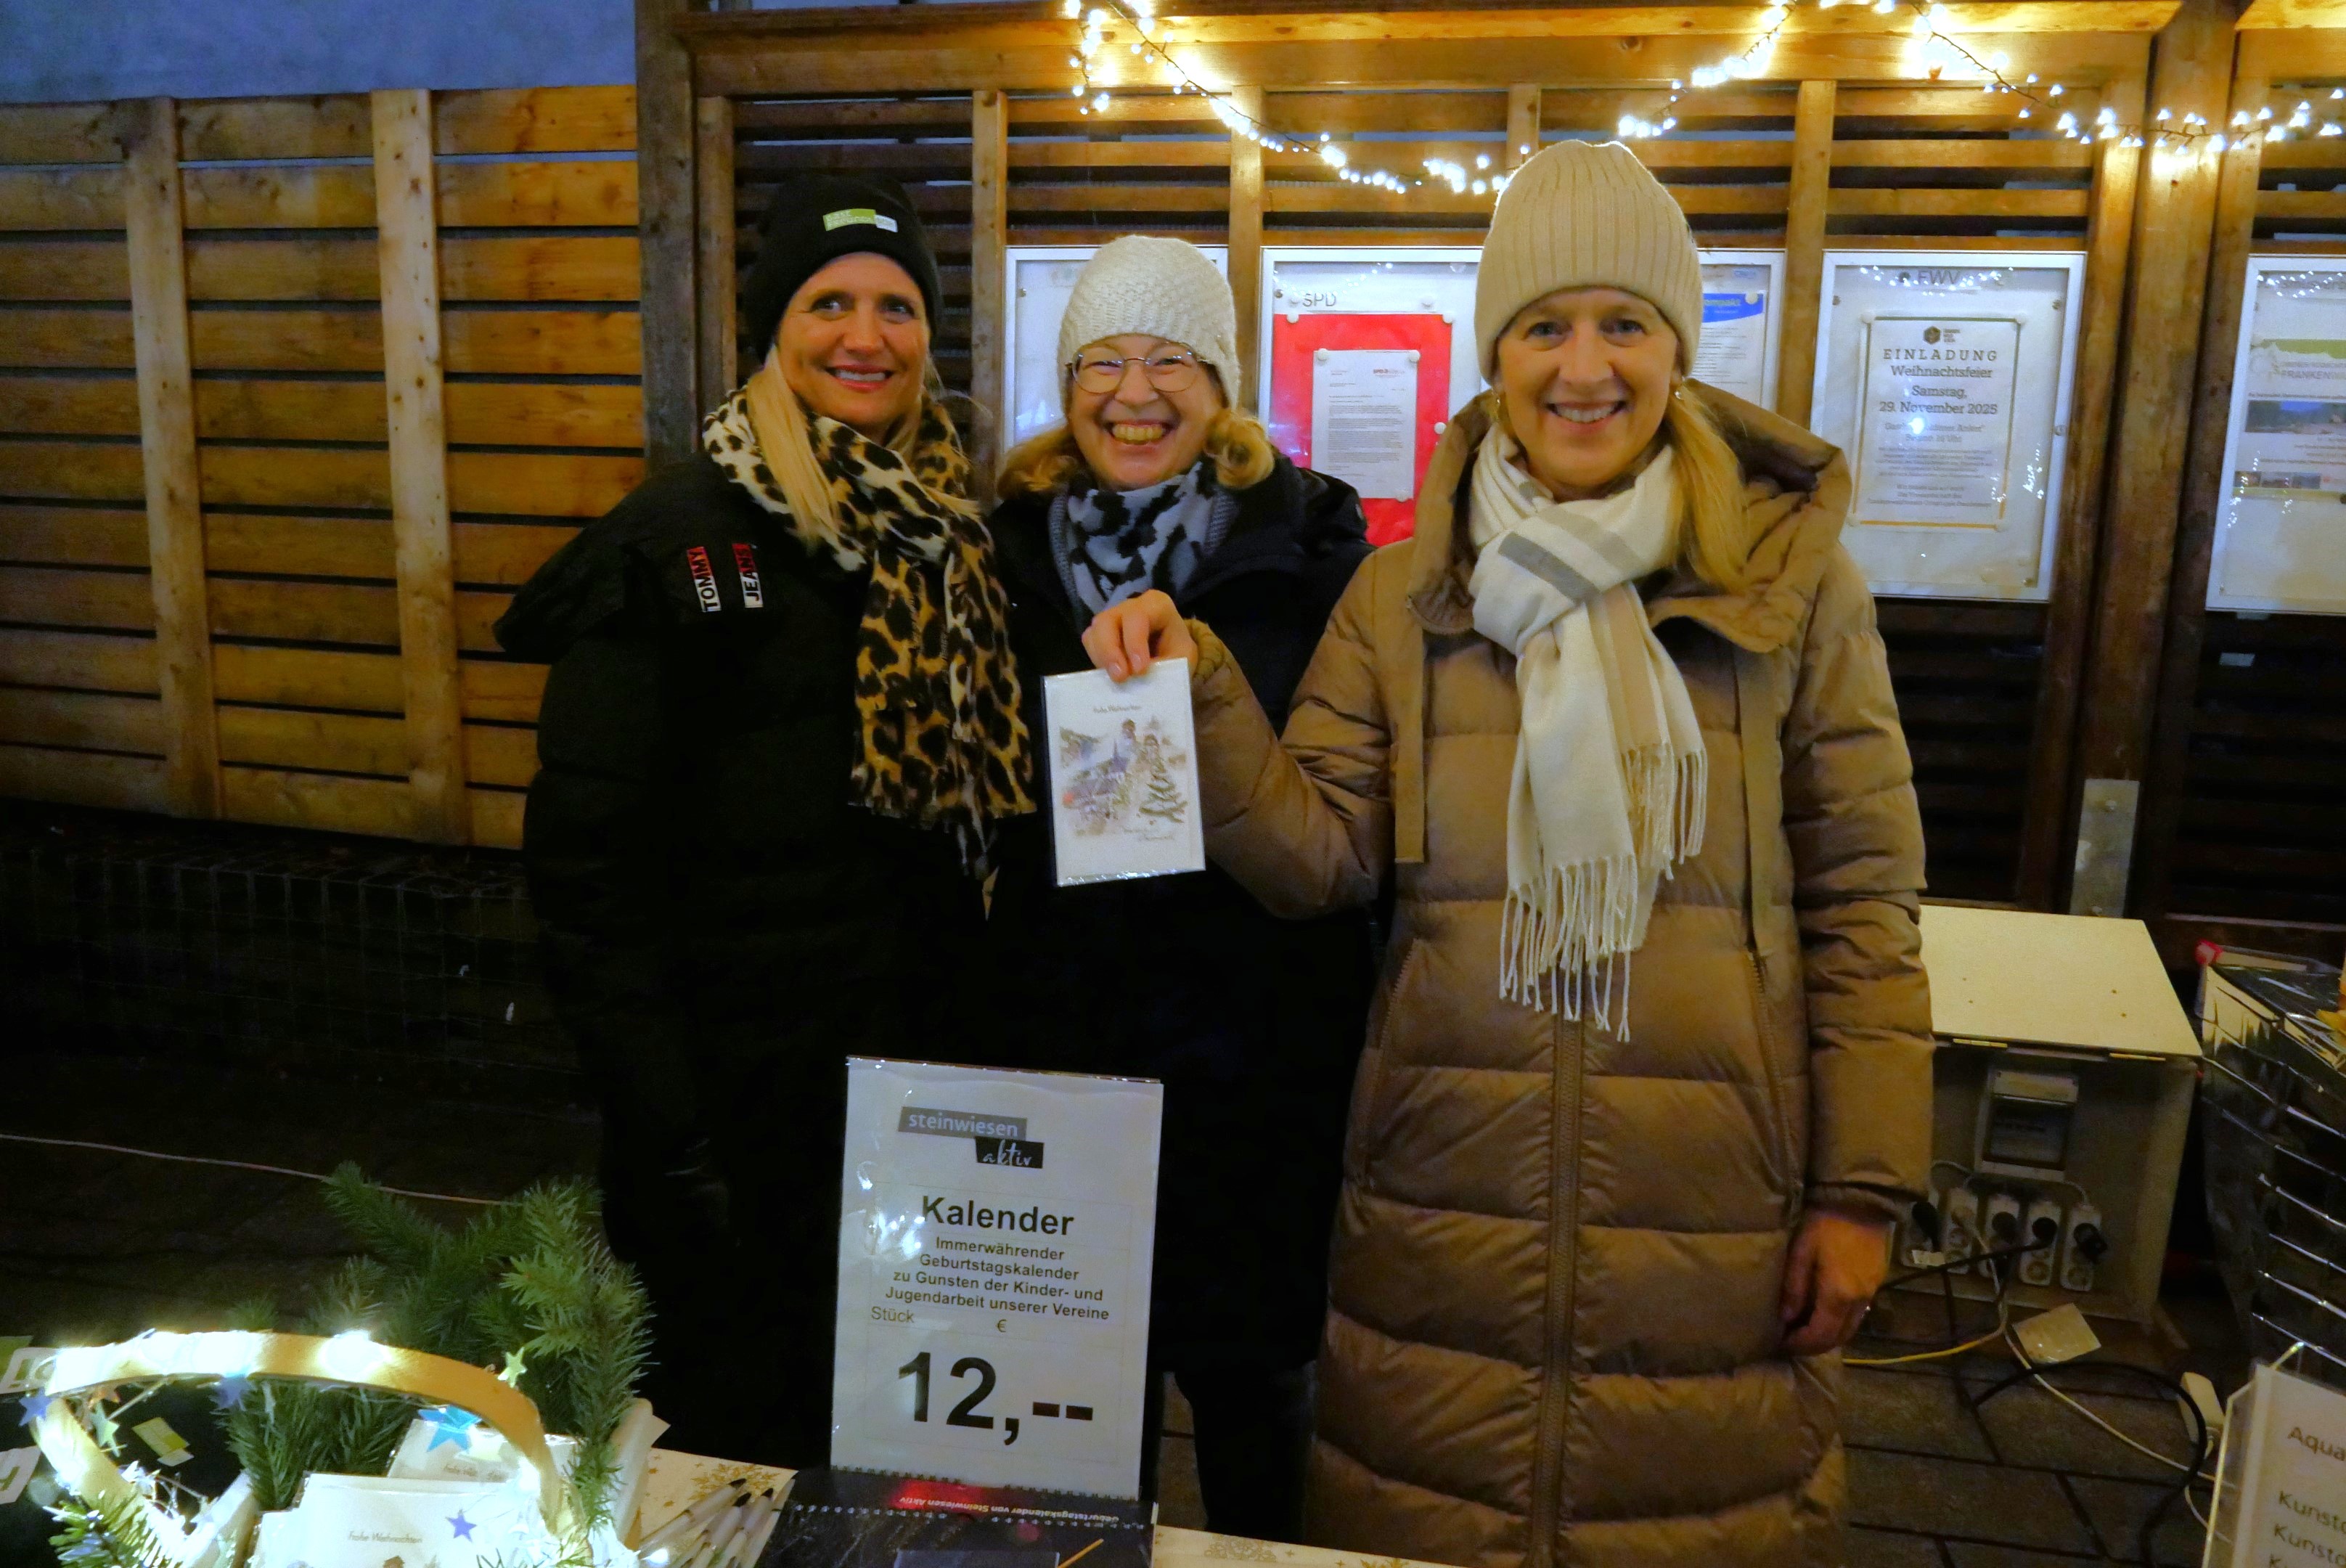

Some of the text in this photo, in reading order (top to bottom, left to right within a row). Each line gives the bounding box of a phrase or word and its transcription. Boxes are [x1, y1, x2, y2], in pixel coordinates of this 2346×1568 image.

[1302, 293, 1336, 307] SPD
[1883, 348, 1997, 361] EINLADUNG
[1891, 365, 1993, 378] Weihnachtsfeier
[1911, 385, 1968, 399] Samstag,
[1900, 401, 1964, 414] November
[1968, 403, 1998, 415] 2025
[688, 550, 719, 610] TOMMY
[909, 1112, 1018, 1137] steinwiesen
[983, 1139, 1032, 1166] aktiv
[923, 1196, 1074, 1236] Kalender
[936, 1236, 1064, 1260] Immerwährender
[920, 1254, 1079, 1281] Geburtstagskalender
[894, 1271, 1103, 1301] zu Gunsten der Kinder- und
[886, 1286, 1109, 1320] Jugendarbeit unserer Vereine
[871, 1306, 1008, 1333] Stück €
[898, 1352, 1094, 1445] 12,--
[928, 1499, 989, 1513] Steinwiesen
